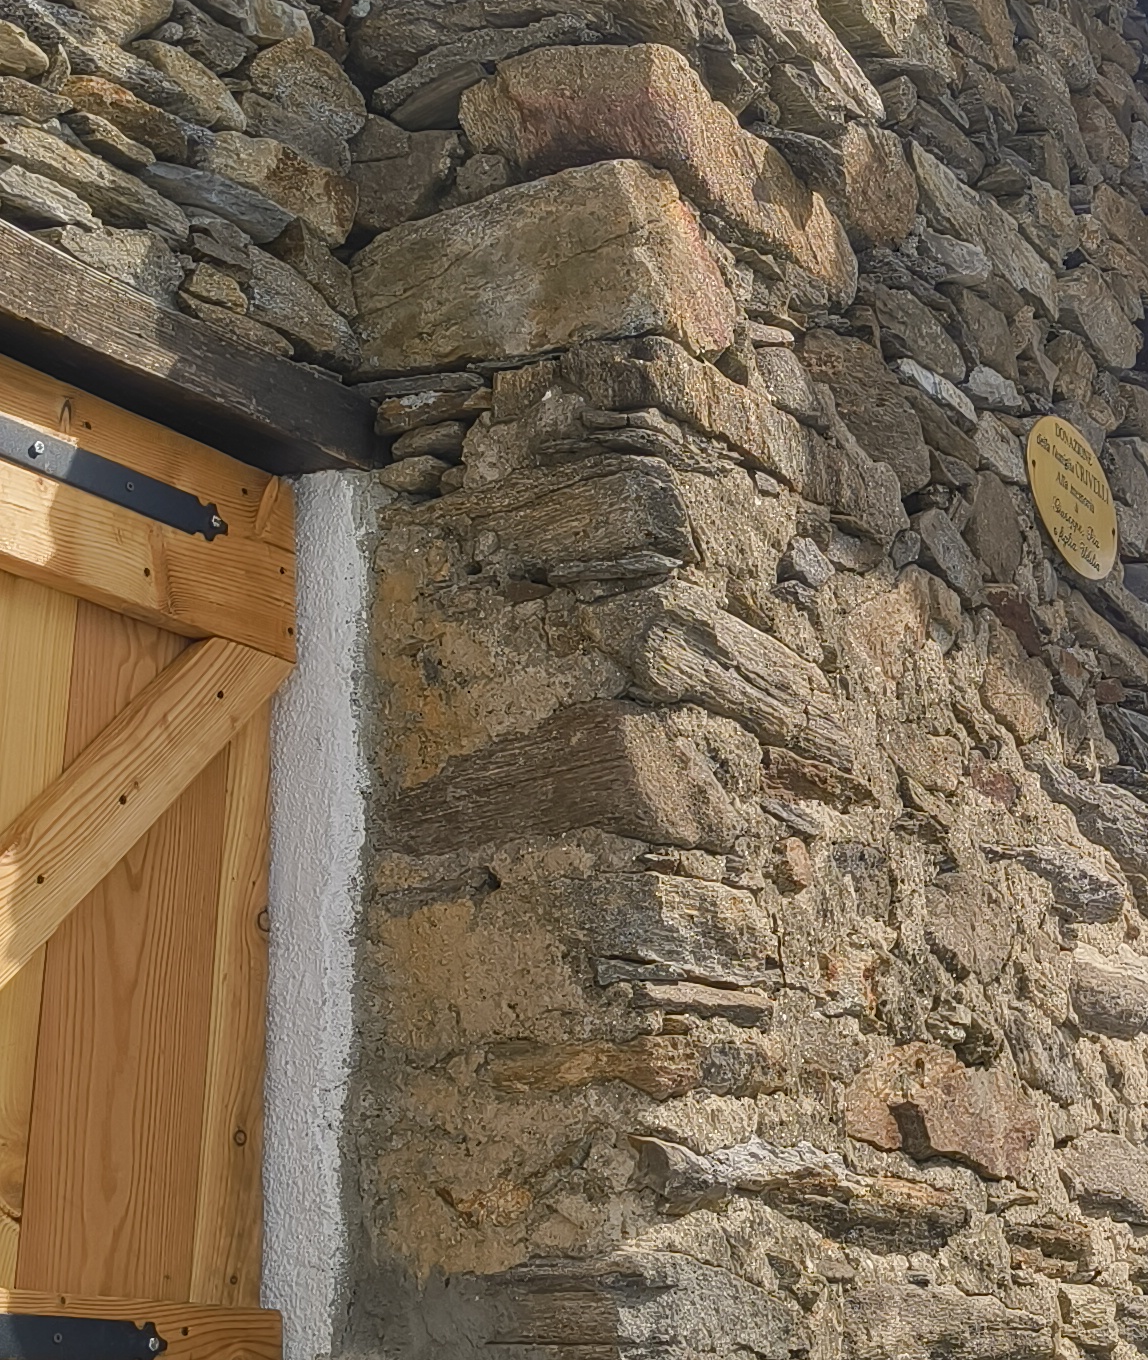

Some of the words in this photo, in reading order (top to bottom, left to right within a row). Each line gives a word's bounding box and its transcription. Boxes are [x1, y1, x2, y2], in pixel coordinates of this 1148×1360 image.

[1055, 423, 1093, 466] DONAZIONE
[1036, 432, 1051, 453] della
[1075, 461, 1109, 504] CRIVELLI
[1056, 471, 1069, 491] Alla
